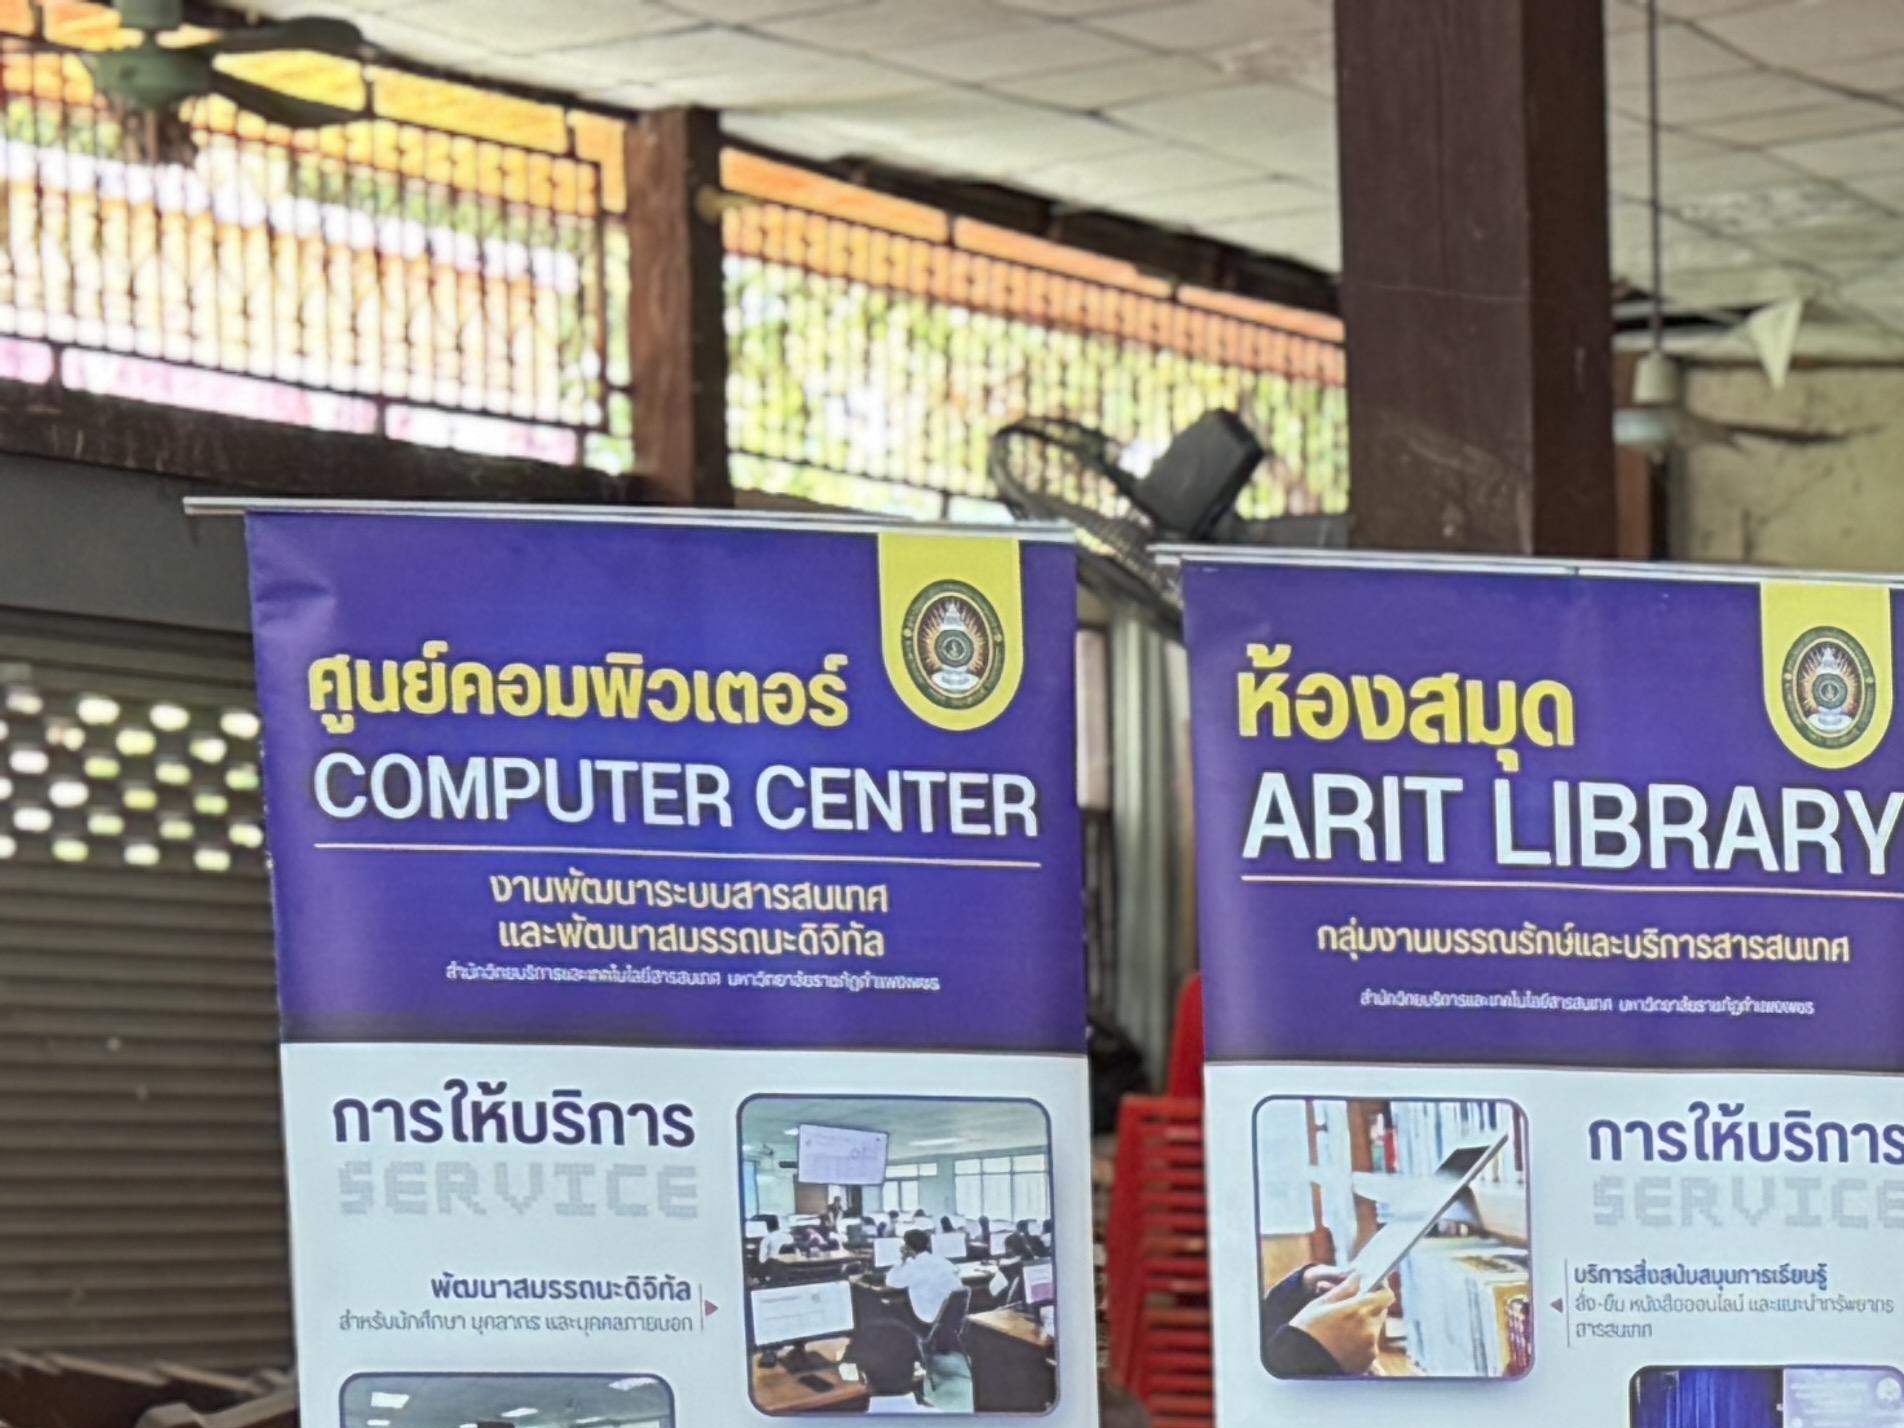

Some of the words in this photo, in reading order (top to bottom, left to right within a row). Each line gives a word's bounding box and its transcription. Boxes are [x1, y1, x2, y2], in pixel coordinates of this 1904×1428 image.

[307, 641, 850, 736] ศูนย์คอมพิวเตอร์
[1236, 643, 1576, 773] ห้องสมุด
[313, 751, 733, 829] COMPUTER
[755, 763, 1040, 837] CENTER
[1242, 771, 1464, 864] ARIT
[489, 869, 889, 914] งานพัฒนาระบบสารสนเทศ
[498, 915, 885, 957] และพัฒนาสมรรถนะดิจิทัล
[1316, 917, 1850, 963] กลุ่มงานบรรณรักษ์และบริการสารสนเทศ
[332, 1078, 696, 1148] การให้บริการ
[337, 1159, 699, 1219] SERVICE
[431, 1271, 692, 1302] พัฒนาสมรรถนะดิจิทัล
